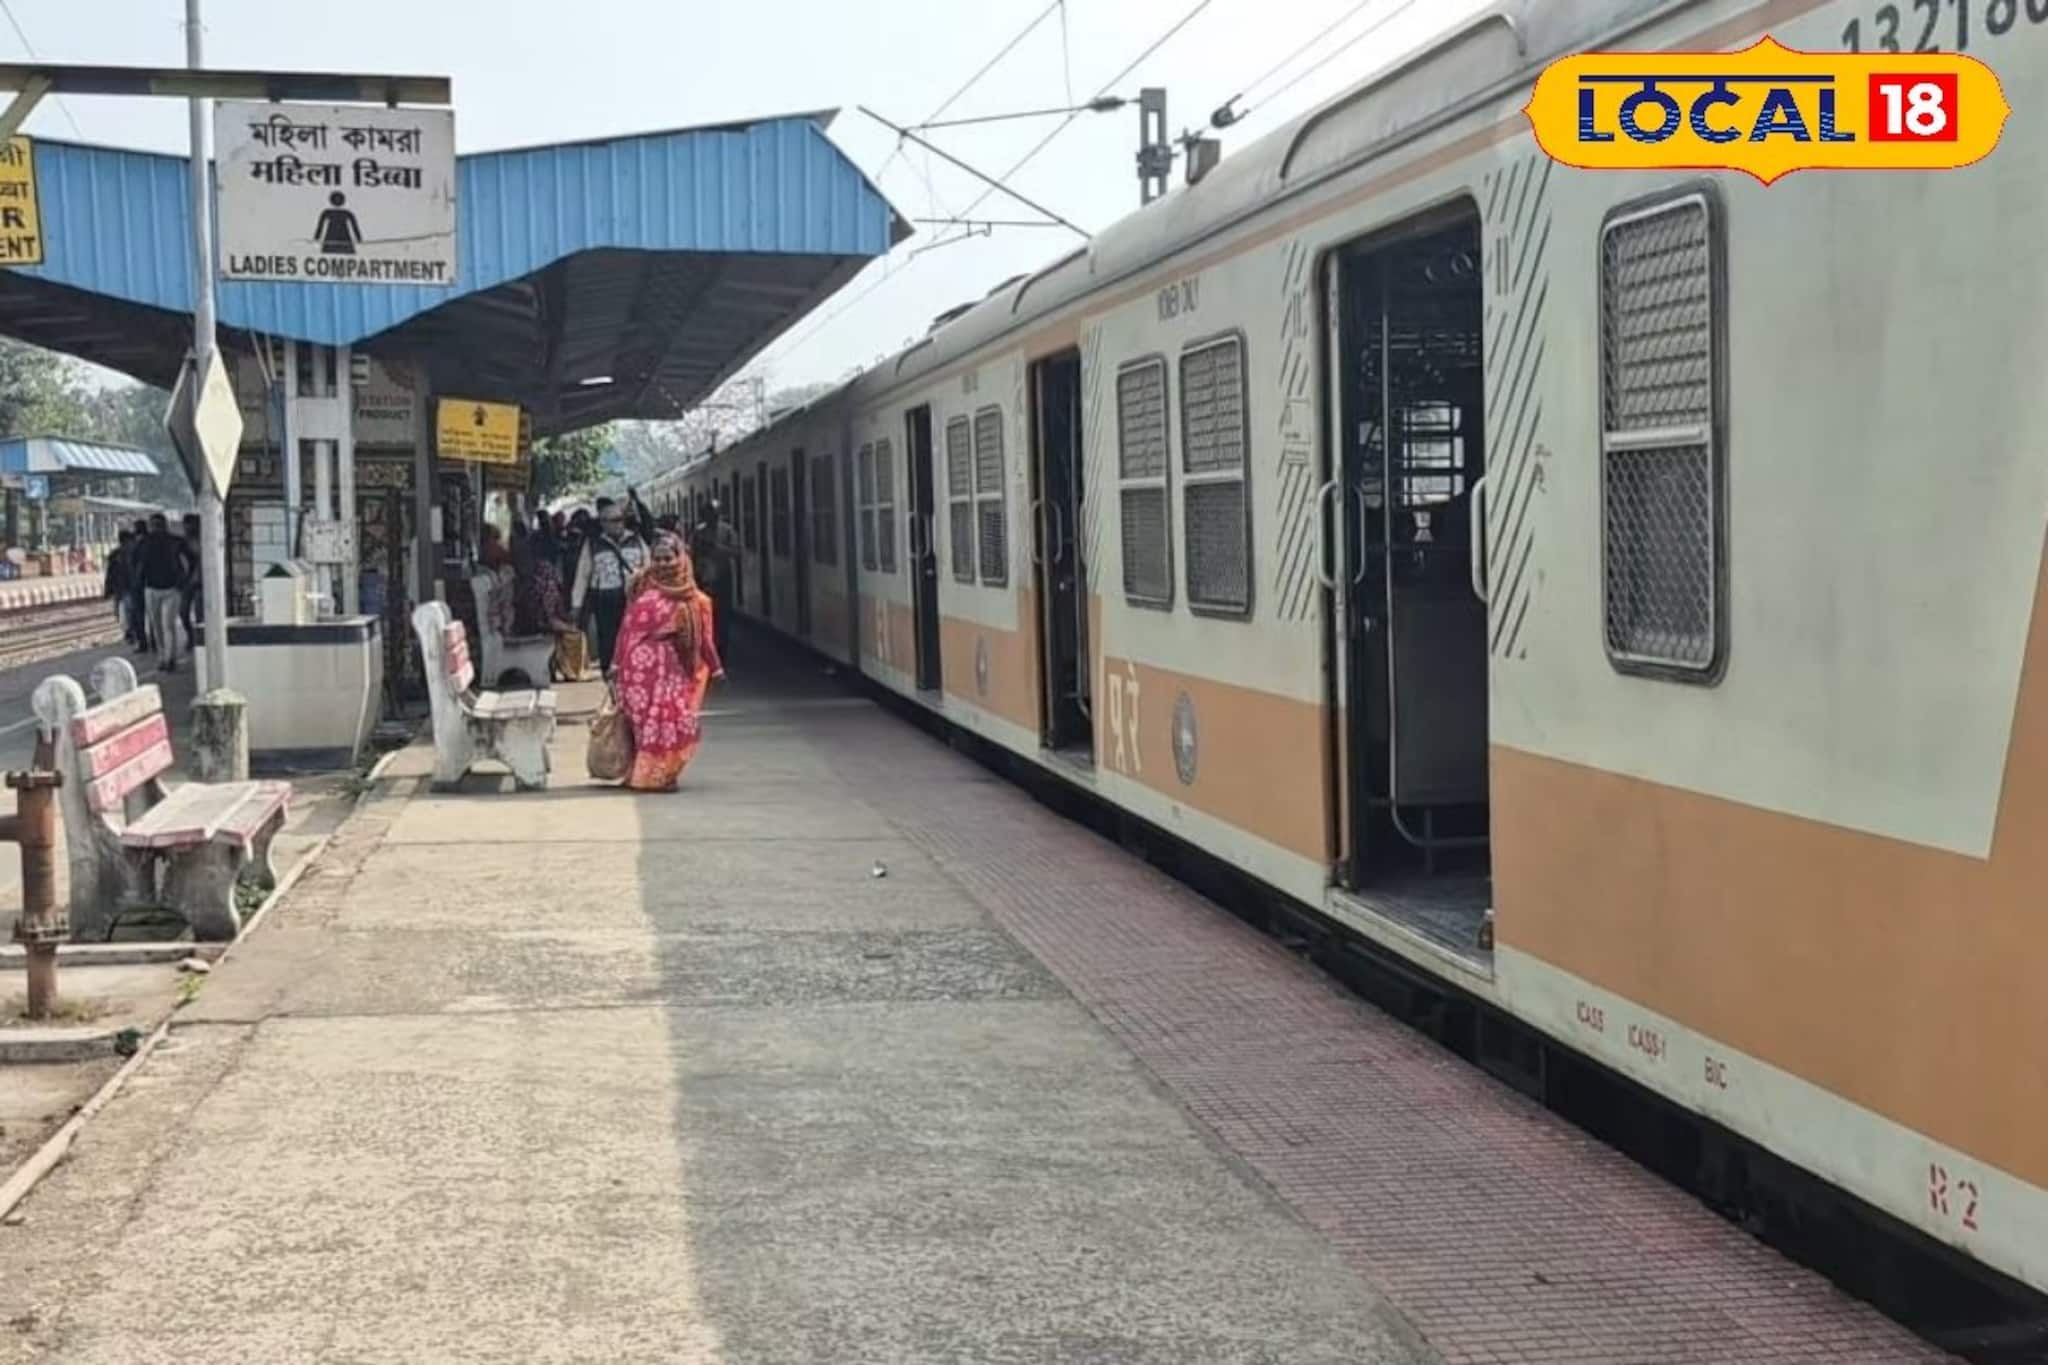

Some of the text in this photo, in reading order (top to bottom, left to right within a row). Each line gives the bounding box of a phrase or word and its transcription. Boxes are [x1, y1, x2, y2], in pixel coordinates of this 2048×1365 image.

[248, 114, 422, 155] মহিলা কামরা
[250, 155, 341, 187] महिला
[230, 255, 447, 281] LADIES COMPARTMENT
